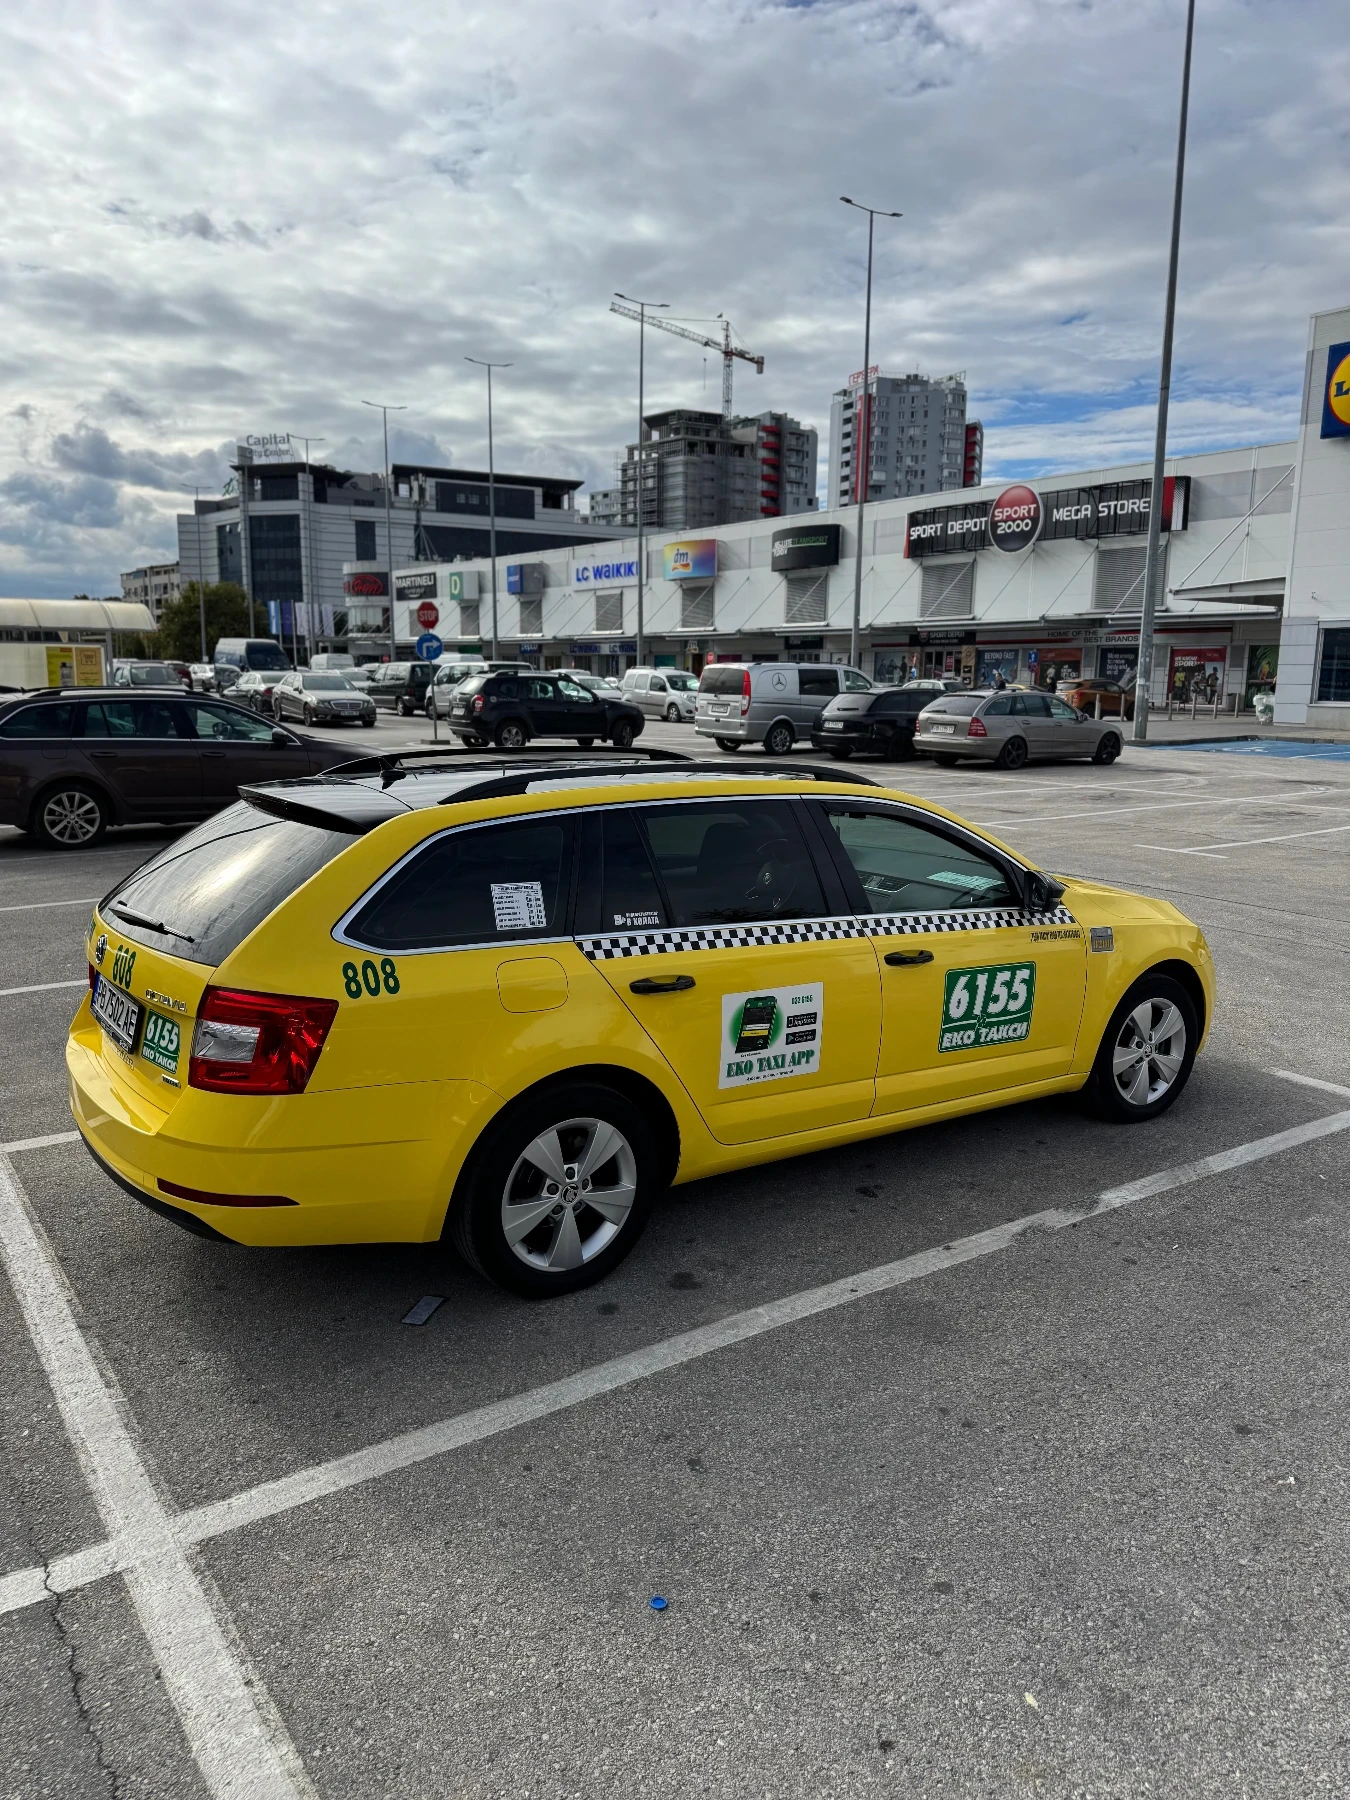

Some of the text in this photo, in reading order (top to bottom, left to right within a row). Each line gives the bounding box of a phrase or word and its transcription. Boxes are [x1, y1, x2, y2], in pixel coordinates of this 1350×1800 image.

[246, 432, 290, 448] Capital
[994, 504, 1037, 520] SPORT
[1052, 498, 1151, 522] MEGA STORE
[909, 517, 988, 540] SPORT DEPOT
[997, 519, 1032, 534] 2000
[673, 548, 689, 563] dm
[396, 574, 434, 588] MARTINELI
[575, 567, 590, 582] LC
[451, 576, 459, 594] D
[419, 610, 438, 621] STOP
[1105, 635, 1139, 643] BRANDS
[984, 651, 1016, 660] BEYOND FAST
[112, 944, 137, 990] 808
[342, 957, 401, 1000] 808
[948, 968, 1031, 1020] 6155
[104, 986, 125, 1028] 7502
[122, 1005, 138, 1040] AE
[146, 1014, 179, 1052] 6155
[941, 1021, 1029, 1049] ЕКО ТАКСИ
[142, 1045, 178, 1072] ЕКО ТАКСИ
[726, 1059, 754, 1078] EKO
[757, 1053, 787, 1072] TAXI
[788, 1049, 815, 1067] APP
